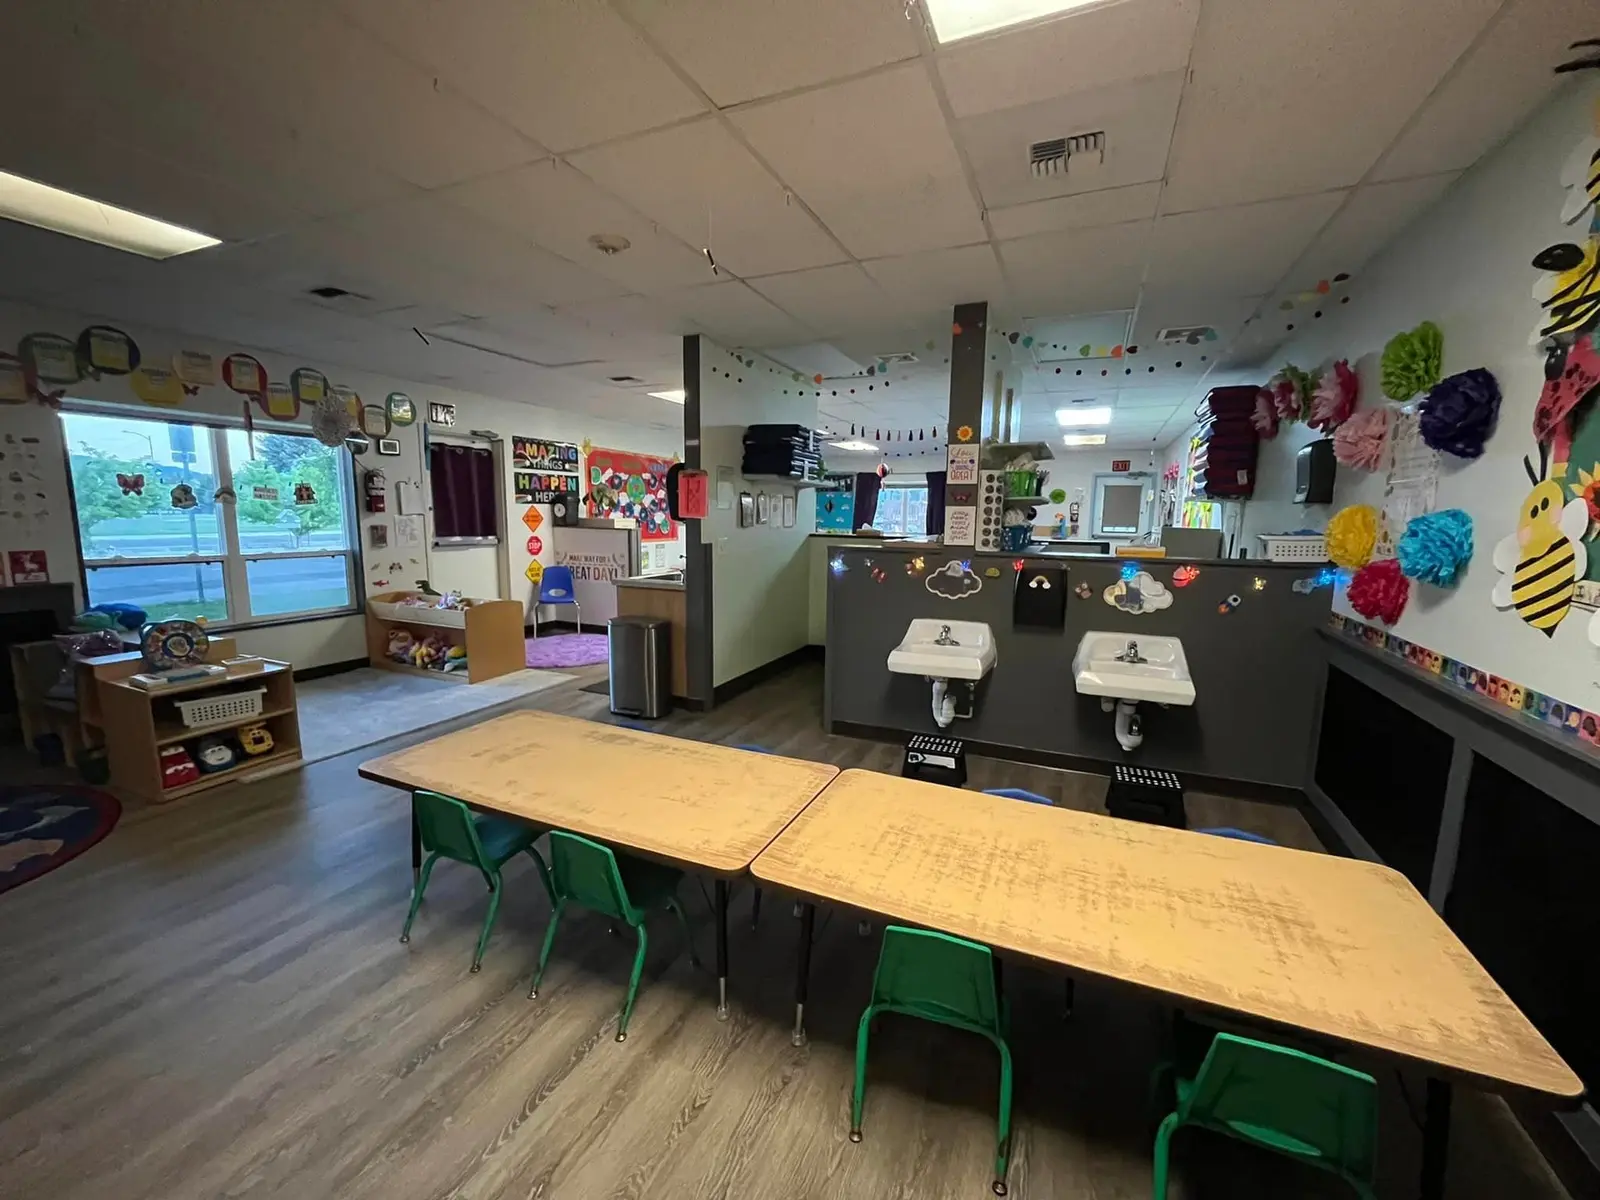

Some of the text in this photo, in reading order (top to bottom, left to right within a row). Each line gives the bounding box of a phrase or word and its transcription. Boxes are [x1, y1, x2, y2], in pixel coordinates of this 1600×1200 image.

[514, 442, 576, 460] AMAZING
[533, 460, 563, 470] THINGS
[1114, 462, 1128, 470] EXIT
[519, 474, 577, 492] HAPPEN
[528, 542, 541, 550] STOP
[568, 566, 591, 580] REAT
[593, 567, 618, 581] DAY!
